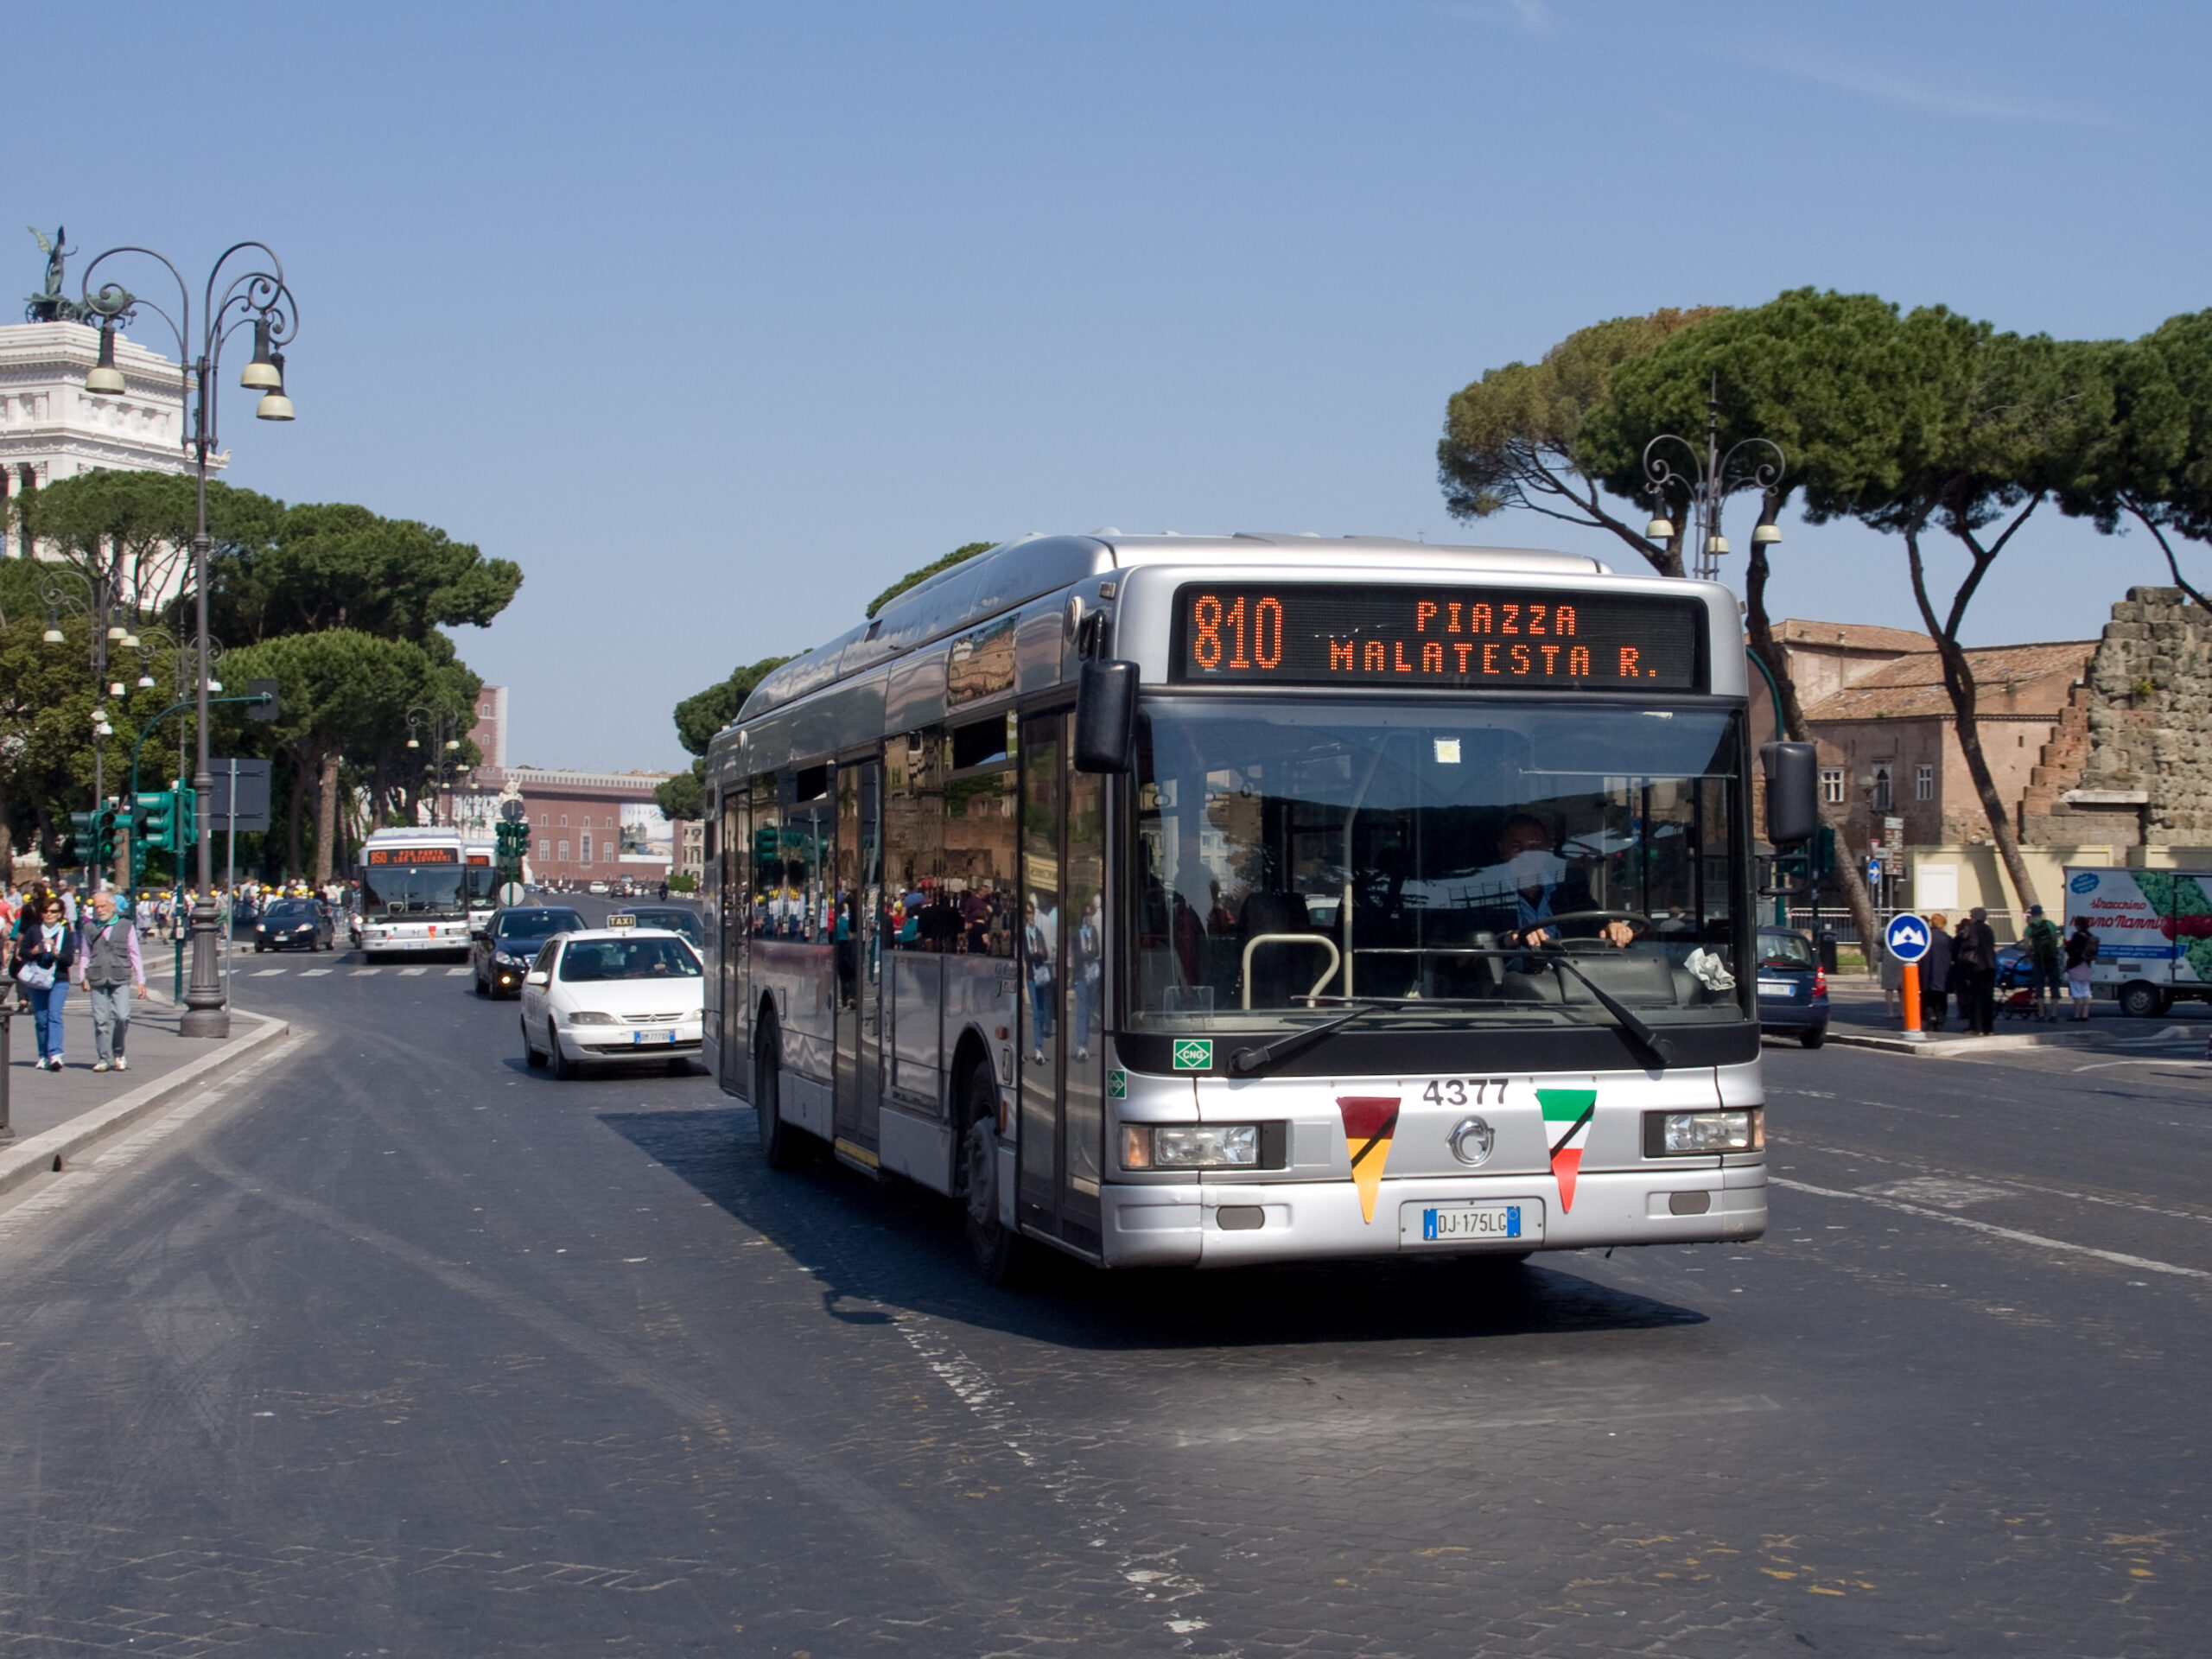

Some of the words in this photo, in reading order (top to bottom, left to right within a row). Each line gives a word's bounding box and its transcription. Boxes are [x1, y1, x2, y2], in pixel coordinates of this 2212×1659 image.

[1195, 595, 1282, 668] 810
[1417, 601, 1576, 636] PIAZZA
[1330, 640, 1589, 677] MALATESTA
[1620, 646, 1656, 677] R.
[370, 851, 387, 863] 850
[2069, 915, 2114, 928] nno
[1182, 1050, 1204, 1059] CNG
[1422, 1078, 1509, 1106] 4377
